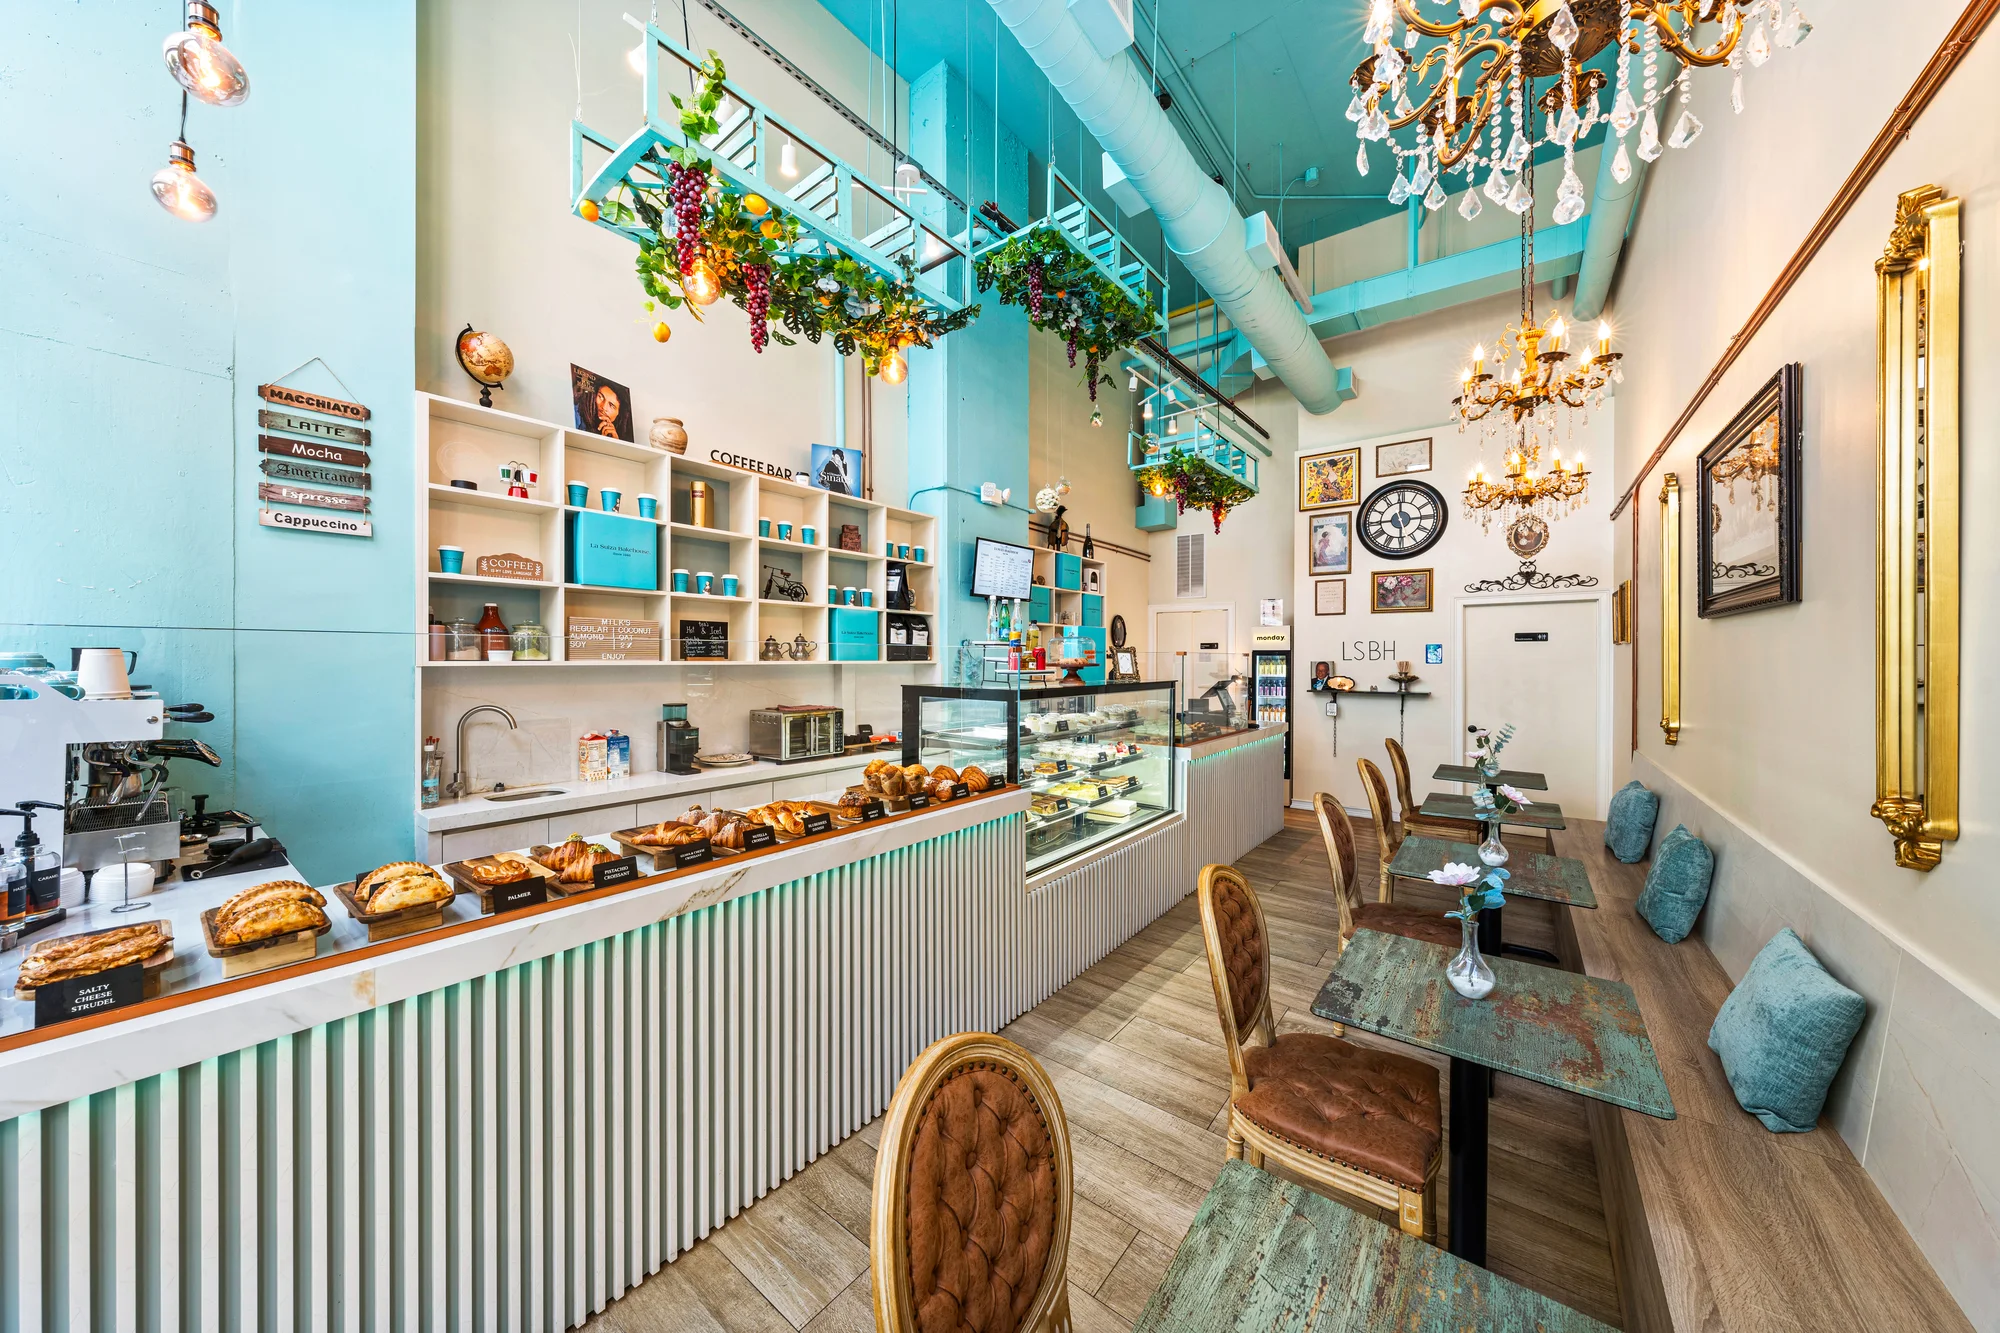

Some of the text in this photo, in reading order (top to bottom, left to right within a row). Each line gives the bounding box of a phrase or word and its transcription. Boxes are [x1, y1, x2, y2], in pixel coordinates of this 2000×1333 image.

[269, 389, 361, 416] MACCHIATO
[286, 418, 346, 437] LATTE
[291, 443, 343, 461] Mocha
[709, 449, 793, 481] COFFEE BAR
[276, 463, 355, 484] Americano
[281, 488, 350, 504] Espresso
[273, 512, 358, 531] Cappuccino
[489, 558, 534, 571] COFFEE
[569, 625, 609, 633] REGULAR
[700, 627, 706, 635] &
[569, 633, 605, 641] ALMOND
[569, 640, 586, 648] SOY
[1342, 640, 1396, 661] LSBH
[603, 871, 631, 880] CROISSANT
[604, 866, 629, 875] PISTACHIO
[507, 891, 532, 901] PALMIER
[79, 984, 110, 996] SALTY
[75, 991, 113, 1004] CHEESE
[71, 998, 116, 1013] STRUDEL
